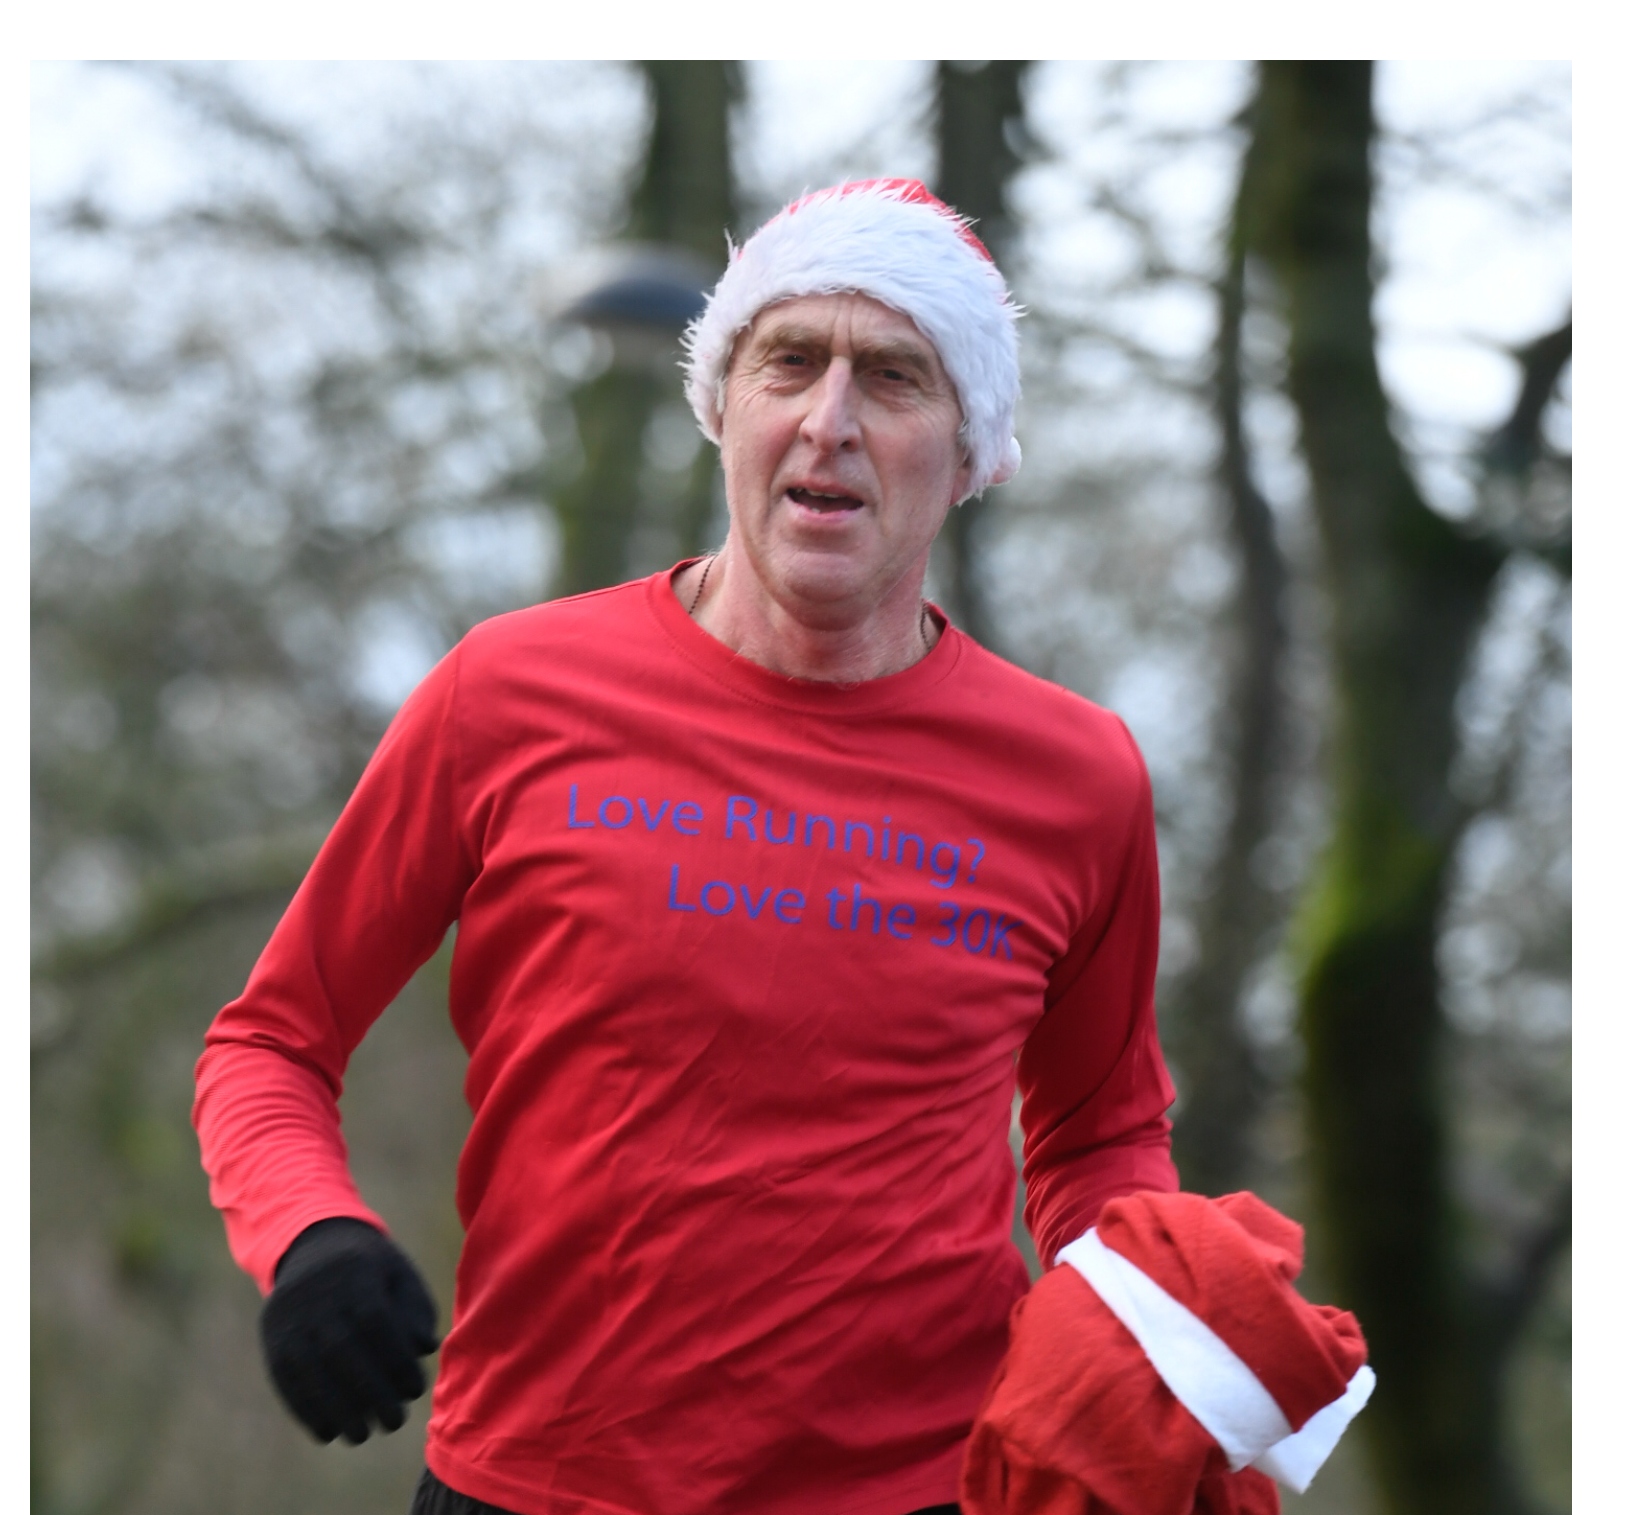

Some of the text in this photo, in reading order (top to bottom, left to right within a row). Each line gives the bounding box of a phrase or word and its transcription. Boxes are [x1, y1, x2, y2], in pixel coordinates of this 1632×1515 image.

[567, 783, 986, 889] Love Running?
[667, 863, 1024, 961] Love the 30K
